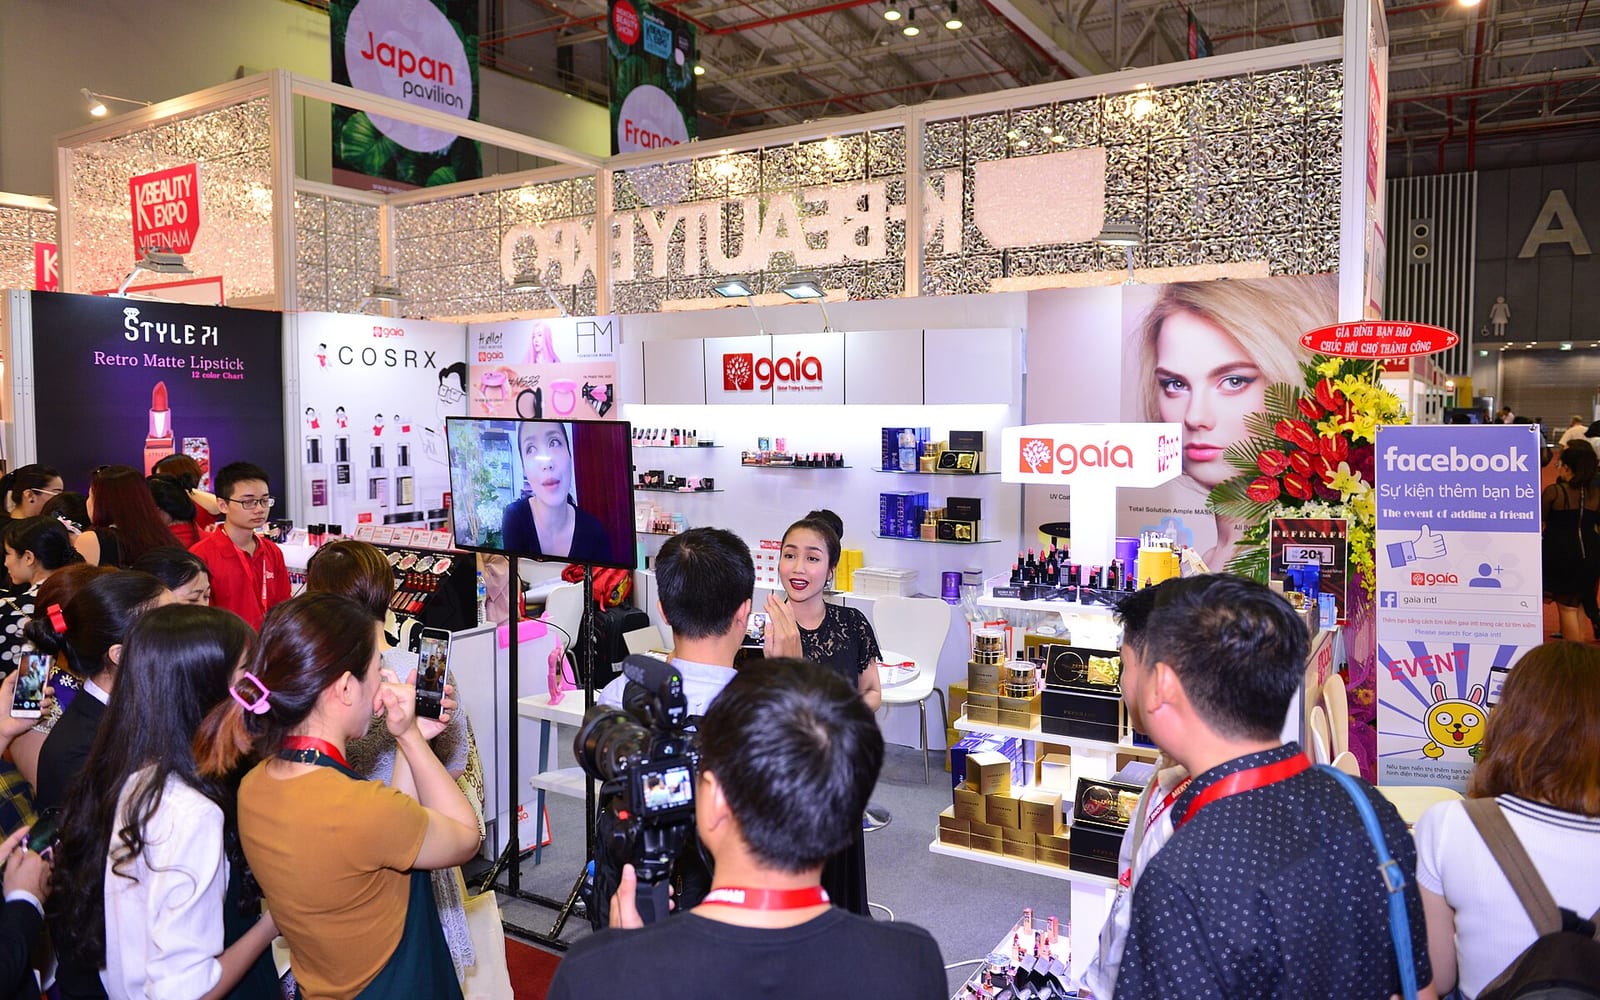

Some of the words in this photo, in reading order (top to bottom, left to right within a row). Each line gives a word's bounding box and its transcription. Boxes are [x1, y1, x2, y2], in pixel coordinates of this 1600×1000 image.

[361, 31, 455, 86] Japan
[402, 81, 463, 109] pavilion
[153, 200, 188, 228] EXPO
[1518, 189, 1592, 259] A
[139, 229, 190, 249] VIETNAM
[124, 316, 196, 345] STYLE
[201, 326, 218, 346] 71
[94, 351, 139, 366] Retro
[143, 353, 186, 368] Matte
[190, 355, 245, 371] Lipstick
[338, 346, 437, 368] COSRX
[191, 371, 201, 379] 12
[1383, 446, 1528, 472] facebook
[1380, 483, 1401, 500] Sự
[1404, 483, 1434, 501] kiện
[1439, 484, 1477, 498] thêm
[1482, 485, 1510, 501] bạn
[1516, 484, 1535, 499] bè
[1382, 509, 1401, 518] The
[1404, 510, 1434, 519] event
[1437, 510, 1448, 519] of
[1451, 510, 1487, 520] adding
[1490, 512, 1497, 520] a
[1500, 511, 1534, 520] friend
[1403, 596, 1422, 605] gaia
[1388, 650, 1468, 681] EVENT
